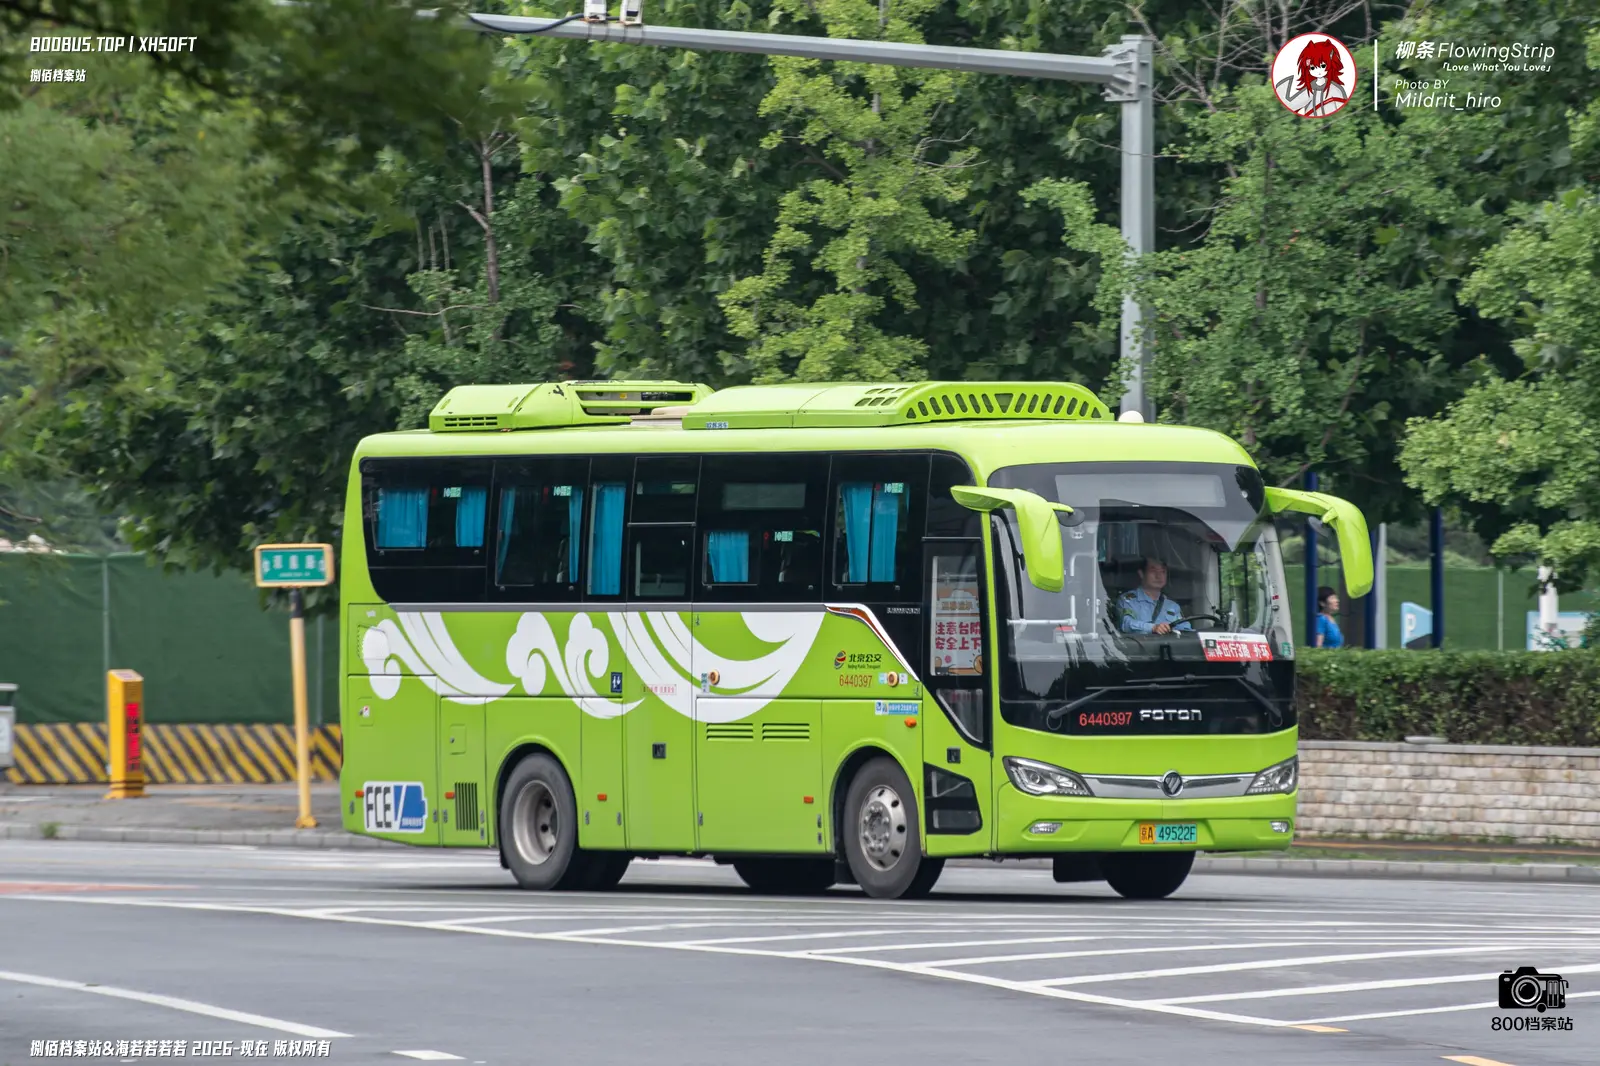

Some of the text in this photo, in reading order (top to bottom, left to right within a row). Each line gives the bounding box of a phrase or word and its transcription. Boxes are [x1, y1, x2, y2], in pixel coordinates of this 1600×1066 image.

[848, 653, 882, 663] 北京公交
[839, 674, 873, 688] 6440397
[1079, 712, 1133, 726] 6440397
[1139, 709, 1202, 721] FOTON
